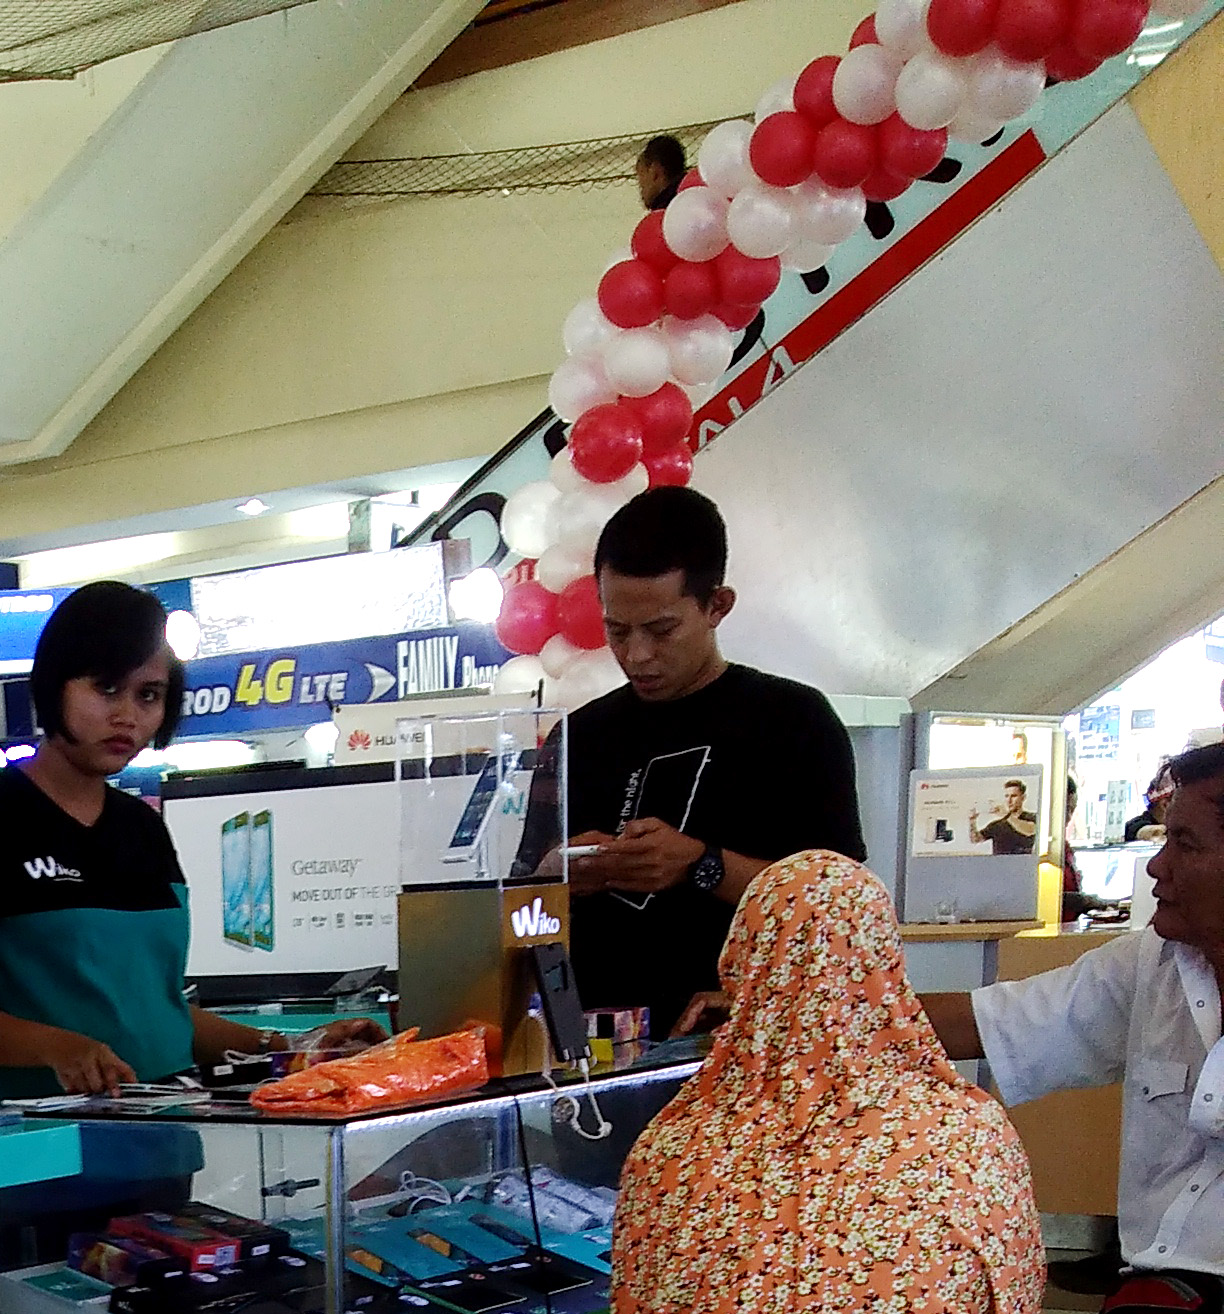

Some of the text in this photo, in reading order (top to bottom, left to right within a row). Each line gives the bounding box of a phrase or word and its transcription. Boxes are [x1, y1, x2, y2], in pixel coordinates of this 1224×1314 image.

[235, 658, 296, 707] 4G
[299, 672, 349, 704] LTE
[397, 635, 459, 700] FAMILY
[23, 855, 82, 879] Wiko
[292, 890, 320, 902] MOVE
[322, 888, 343, 901] OUT
[511, 897, 561, 938] Wiko
